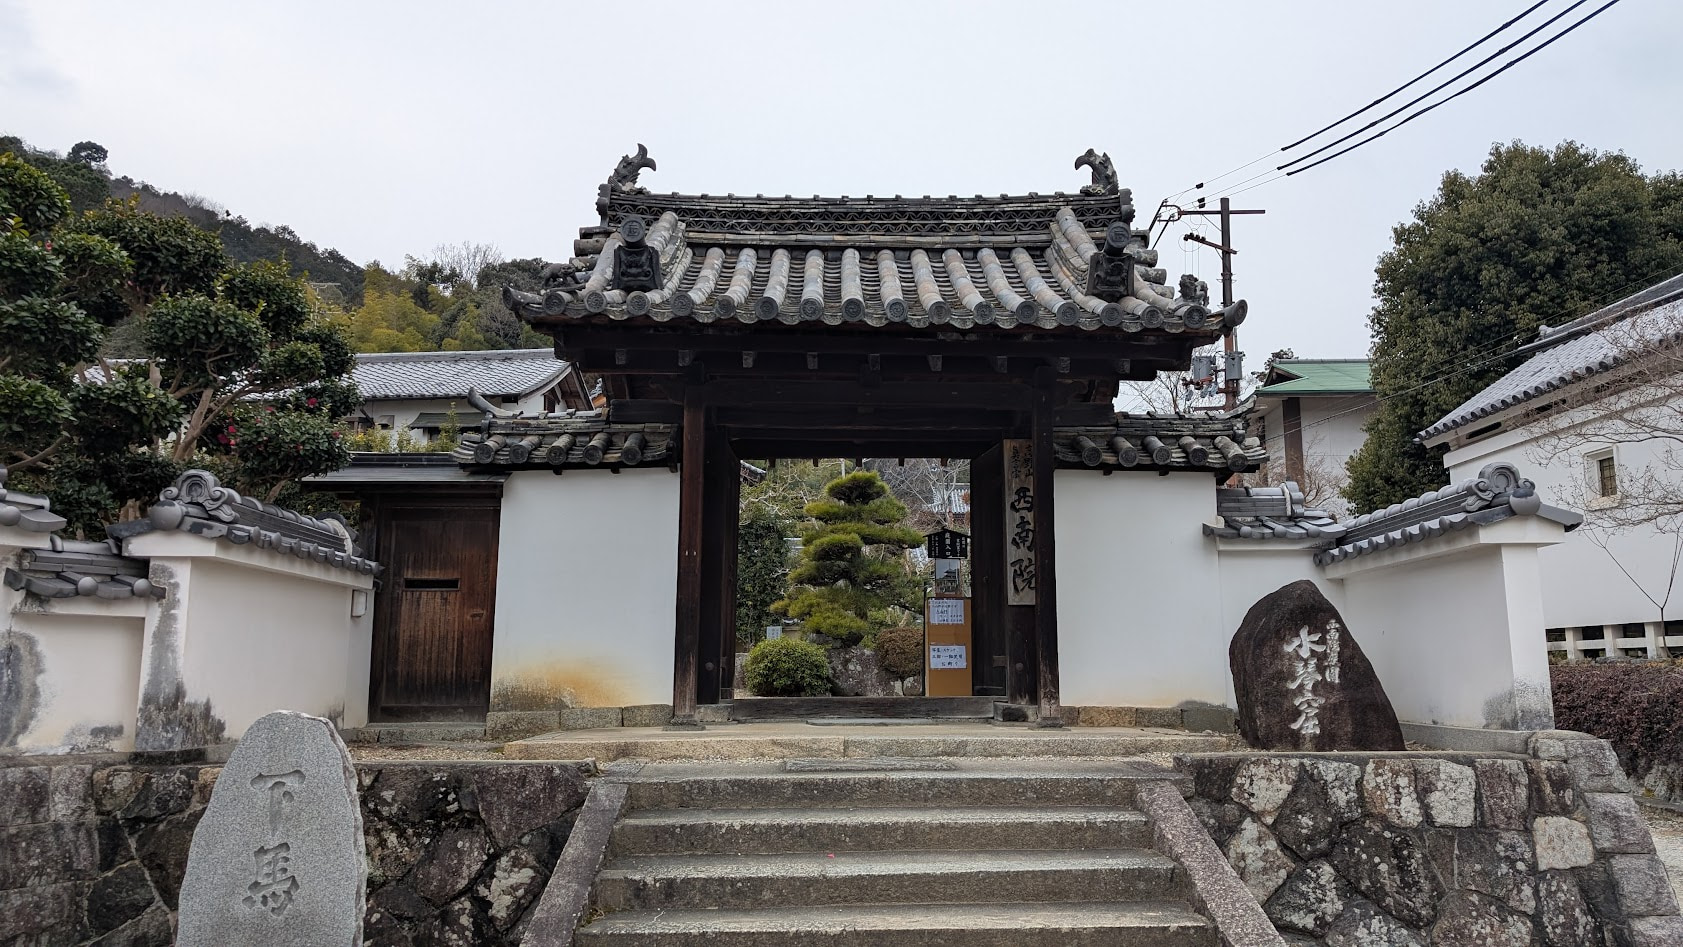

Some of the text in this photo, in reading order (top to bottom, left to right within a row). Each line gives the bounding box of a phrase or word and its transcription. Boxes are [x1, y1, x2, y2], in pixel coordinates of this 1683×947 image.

[1010, 486, 1036, 593] 西南院
[1283, 624, 1327, 735] 水琴窟
[242, 769, 306, 918] 下馬
